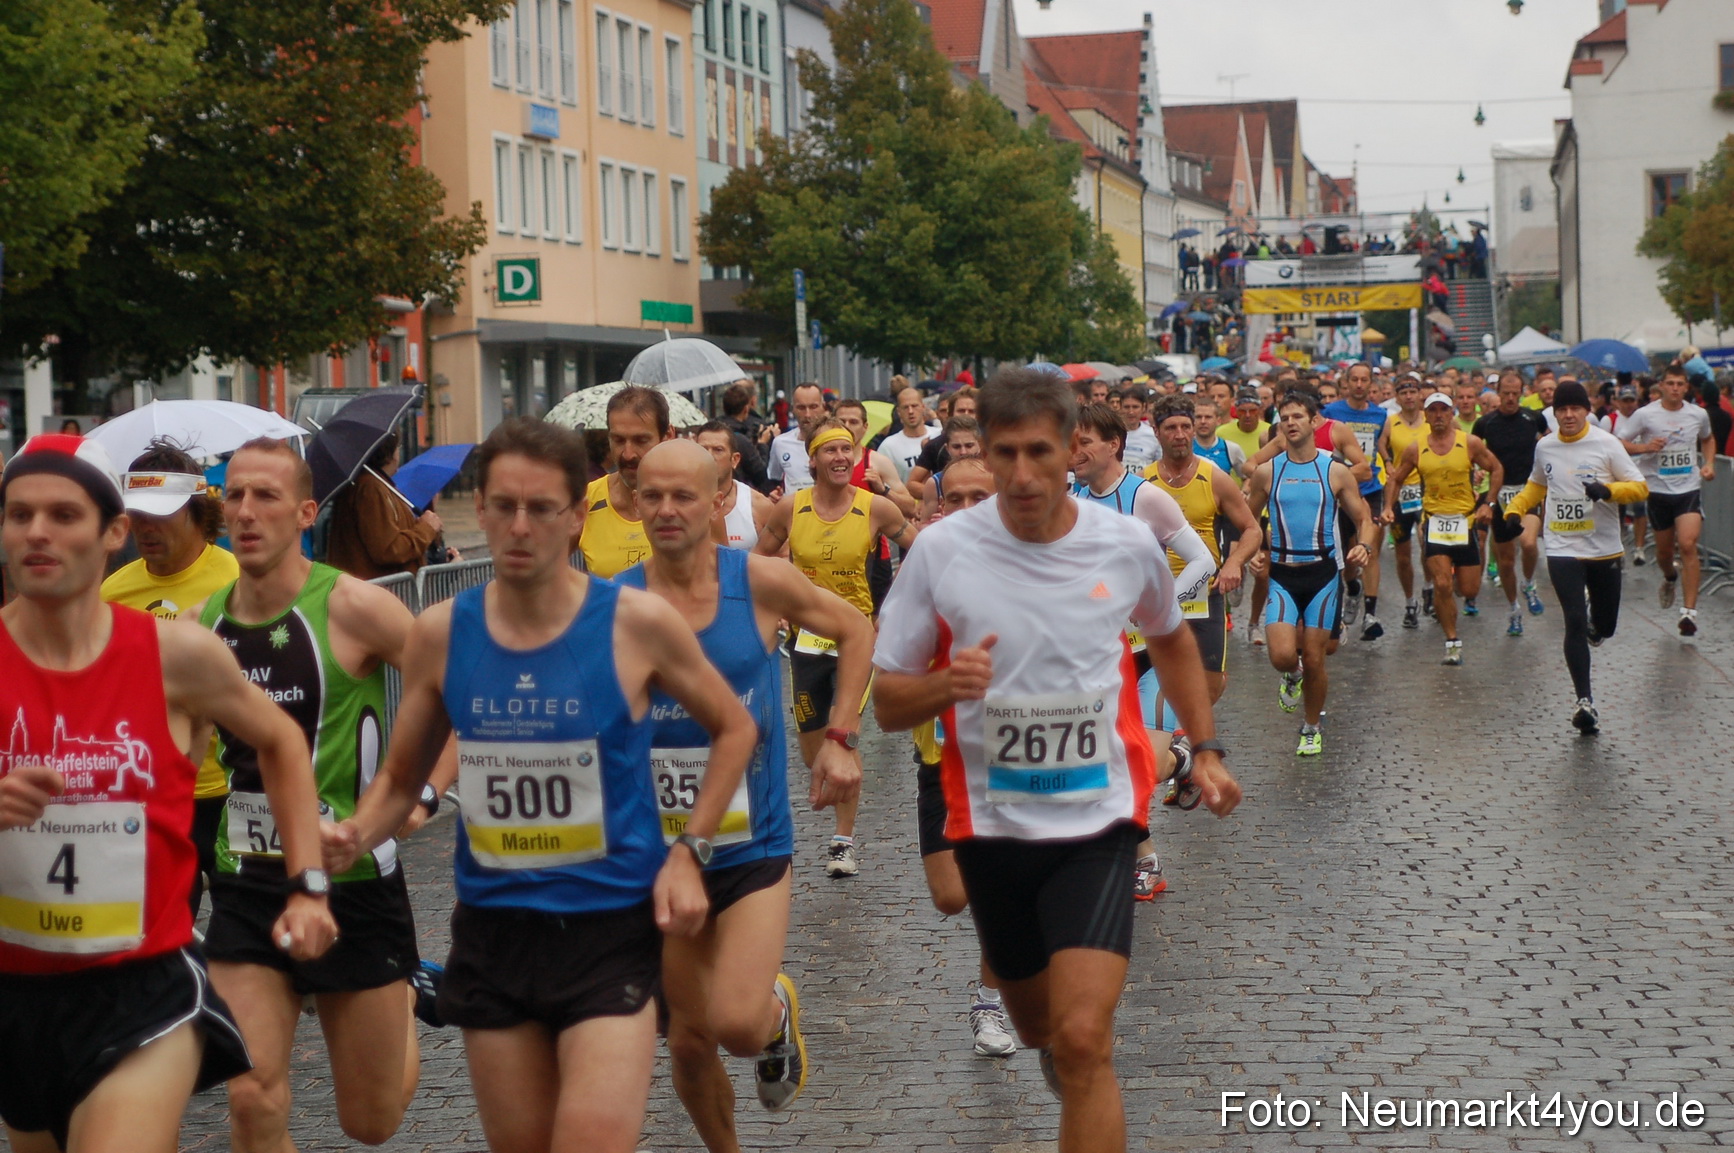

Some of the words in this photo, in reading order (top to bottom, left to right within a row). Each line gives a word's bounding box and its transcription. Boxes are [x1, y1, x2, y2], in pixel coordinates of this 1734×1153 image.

[503, 265, 533, 296] D
[1302, 291, 1362, 307] START
[1660, 453, 1691, 467] 2166
[1557, 504, 1584, 520] 526
[472, 698, 580, 715] ELOTEC
[986, 707, 1027, 718] PARTL
[1030, 705, 1089, 718] Neumarkt
[997, 719, 1097, 764] 2676
[460, 754, 503, 768] PARTL
[506, 756, 572, 769] Neumarkt
[1029, 773, 1067, 791] Rudi
[486, 774, 573, 821] 500
[228, 799, 257, 814] PARTL
[41, 820, 117, 835] Neumarkt
[501, 833, 561, 851] Martin
[47, 843, 79, 896] 4
[39, 910, 83, 932] Uwe
